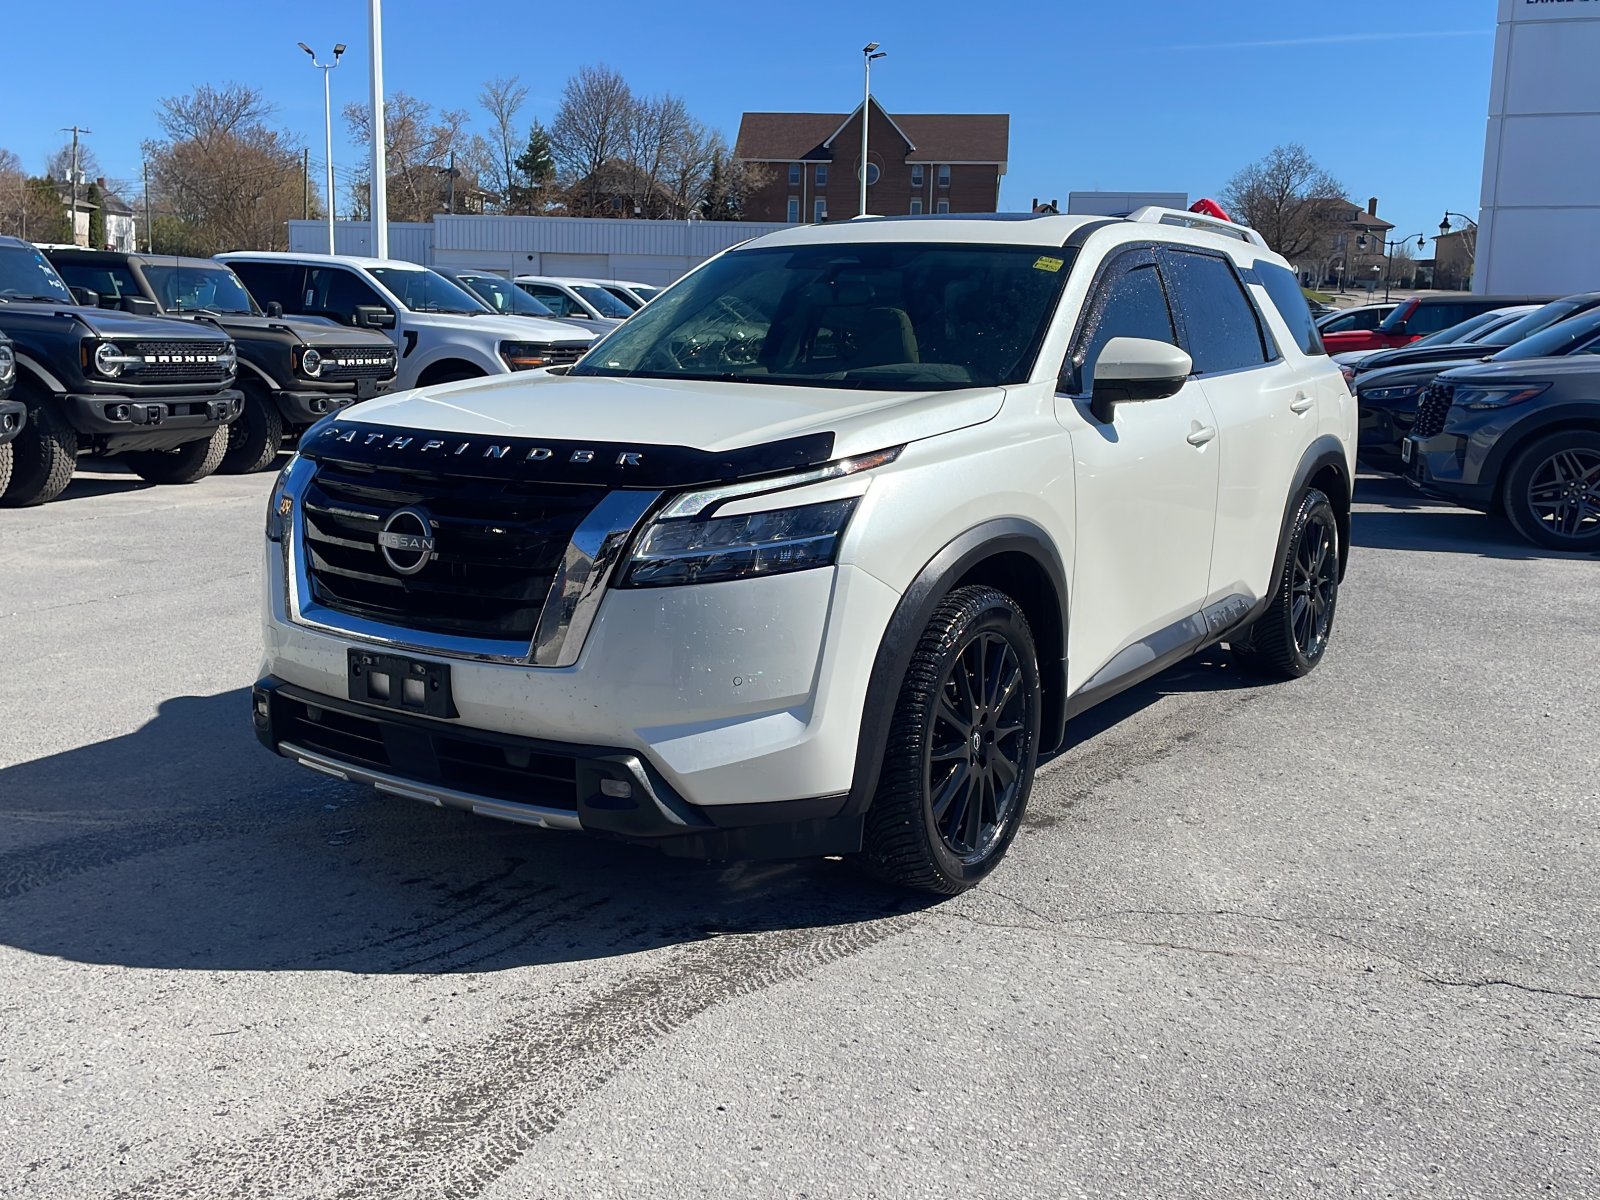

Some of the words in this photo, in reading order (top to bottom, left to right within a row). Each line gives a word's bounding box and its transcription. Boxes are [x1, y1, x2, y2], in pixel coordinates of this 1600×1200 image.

[144, 355, 217, 363] BRONCO
[337, 358, 387, 366] BRONCO
[319, 427, 643, 465] PATHFINDER
